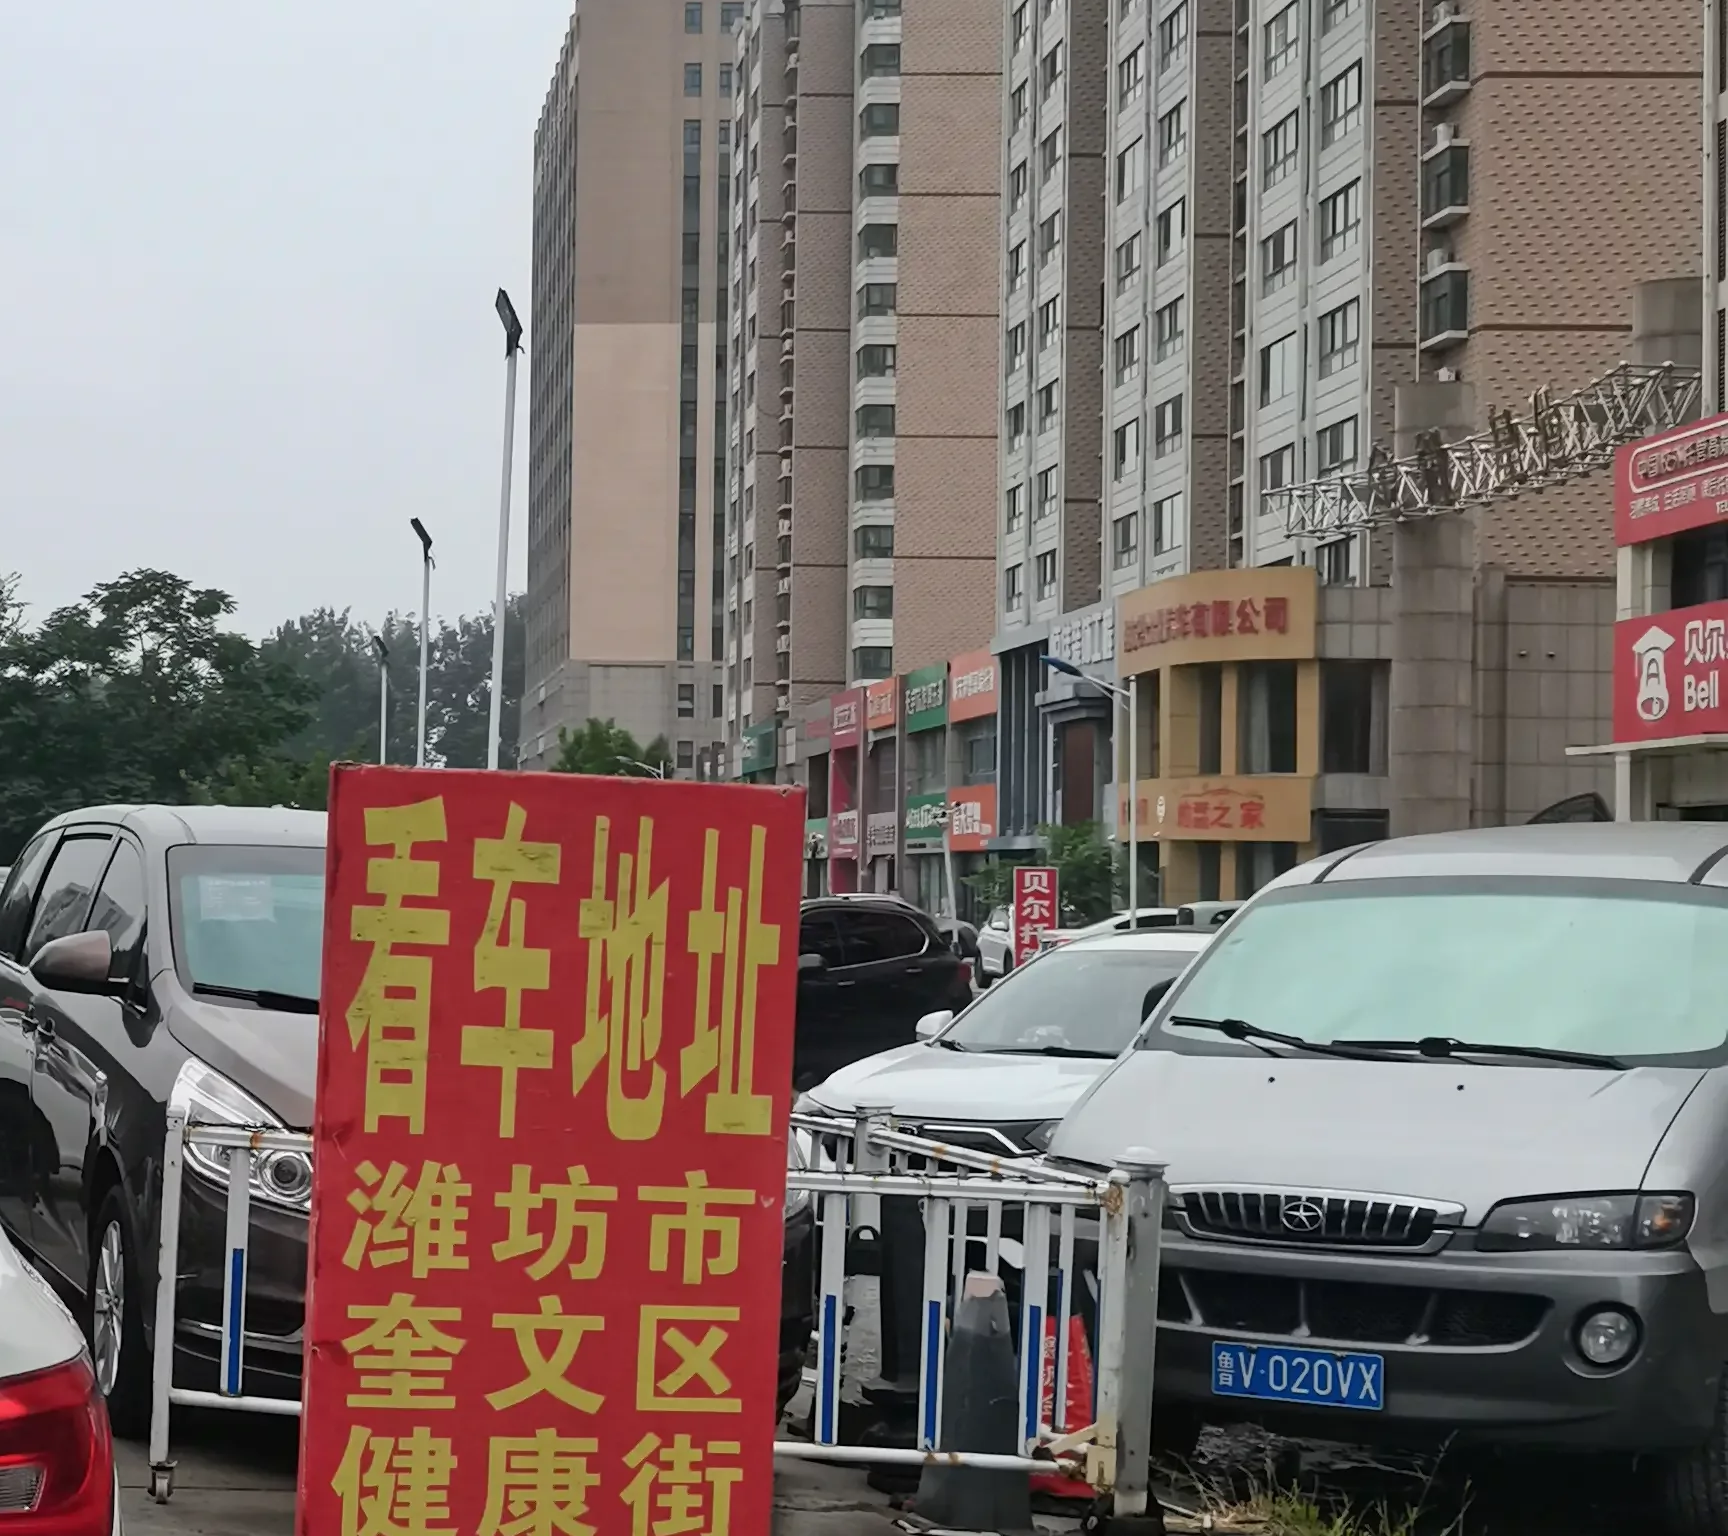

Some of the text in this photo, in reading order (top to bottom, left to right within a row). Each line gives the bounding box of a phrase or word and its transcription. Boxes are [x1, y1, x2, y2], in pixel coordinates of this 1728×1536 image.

[1684, 669, 1719, 712] Bell
[344, 795, 781, 1141] 看车地址
[1019, 871, 1051, 961] 贝尔托
[342, 1159, 756, 1285] 潍坊市
[341, 1293, 743, 1414] 奎文区
